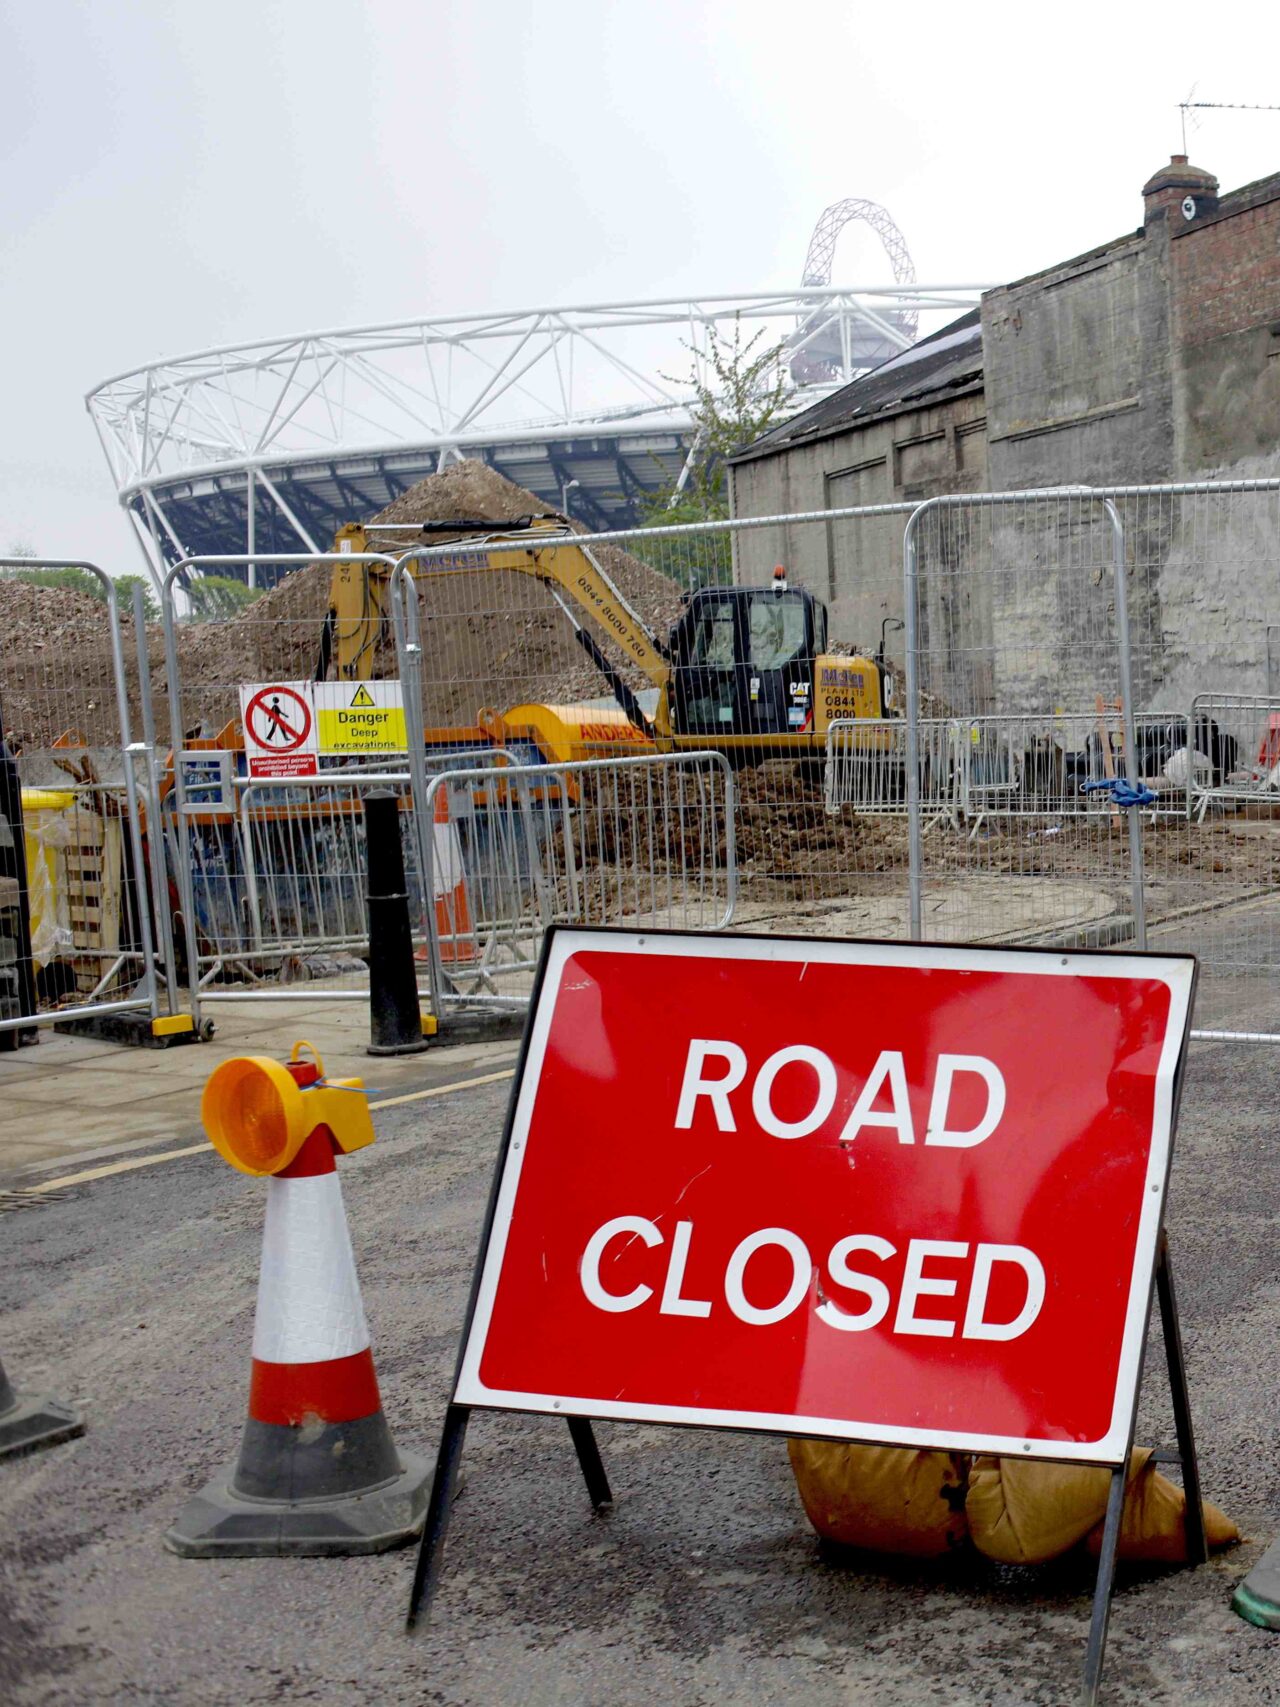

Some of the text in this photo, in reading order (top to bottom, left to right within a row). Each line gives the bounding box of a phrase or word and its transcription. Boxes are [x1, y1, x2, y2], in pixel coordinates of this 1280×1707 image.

[577, 577, 604, 606] 0844
[602, 606, 628, 635] 8000
[789, 682, 810, 695] CAT
[820, 688, 849, 696] PLANT
[825, 696, 856, 706] 0844
[338, 712, 389, 725] Danger
[826, 709, 856, 719] 8000
[351, 728, 378, 738] Deep
[333, 740, 396, 750] excavations
[674, 1039, 1006, 1149] ROAD
[580, 1215, 1046, 1342] CLOSED
